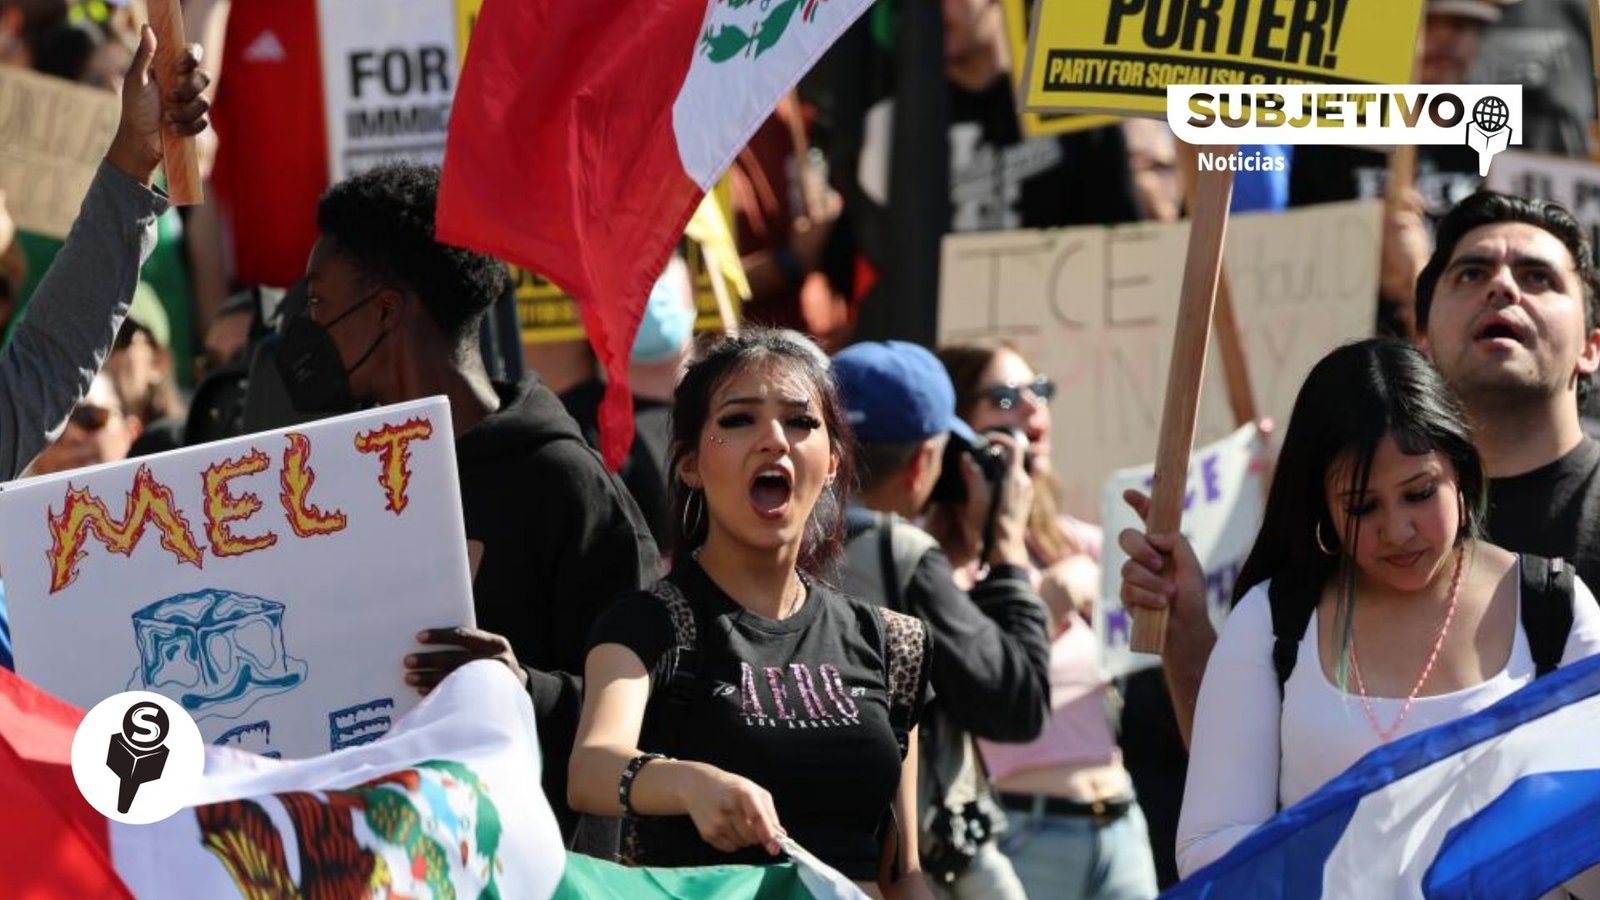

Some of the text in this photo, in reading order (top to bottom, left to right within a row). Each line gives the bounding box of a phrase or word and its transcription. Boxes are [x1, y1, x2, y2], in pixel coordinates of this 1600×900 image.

[350, 47, 449, 98] FOR
[1050, 57, 1105, 85] PARTY
[1107, 59, 1142, 87] FOR
[947, 229, 1160, 338] ICE
[48, 416, 432, 594] MELT
[740, 662, 859, 719] AERO
